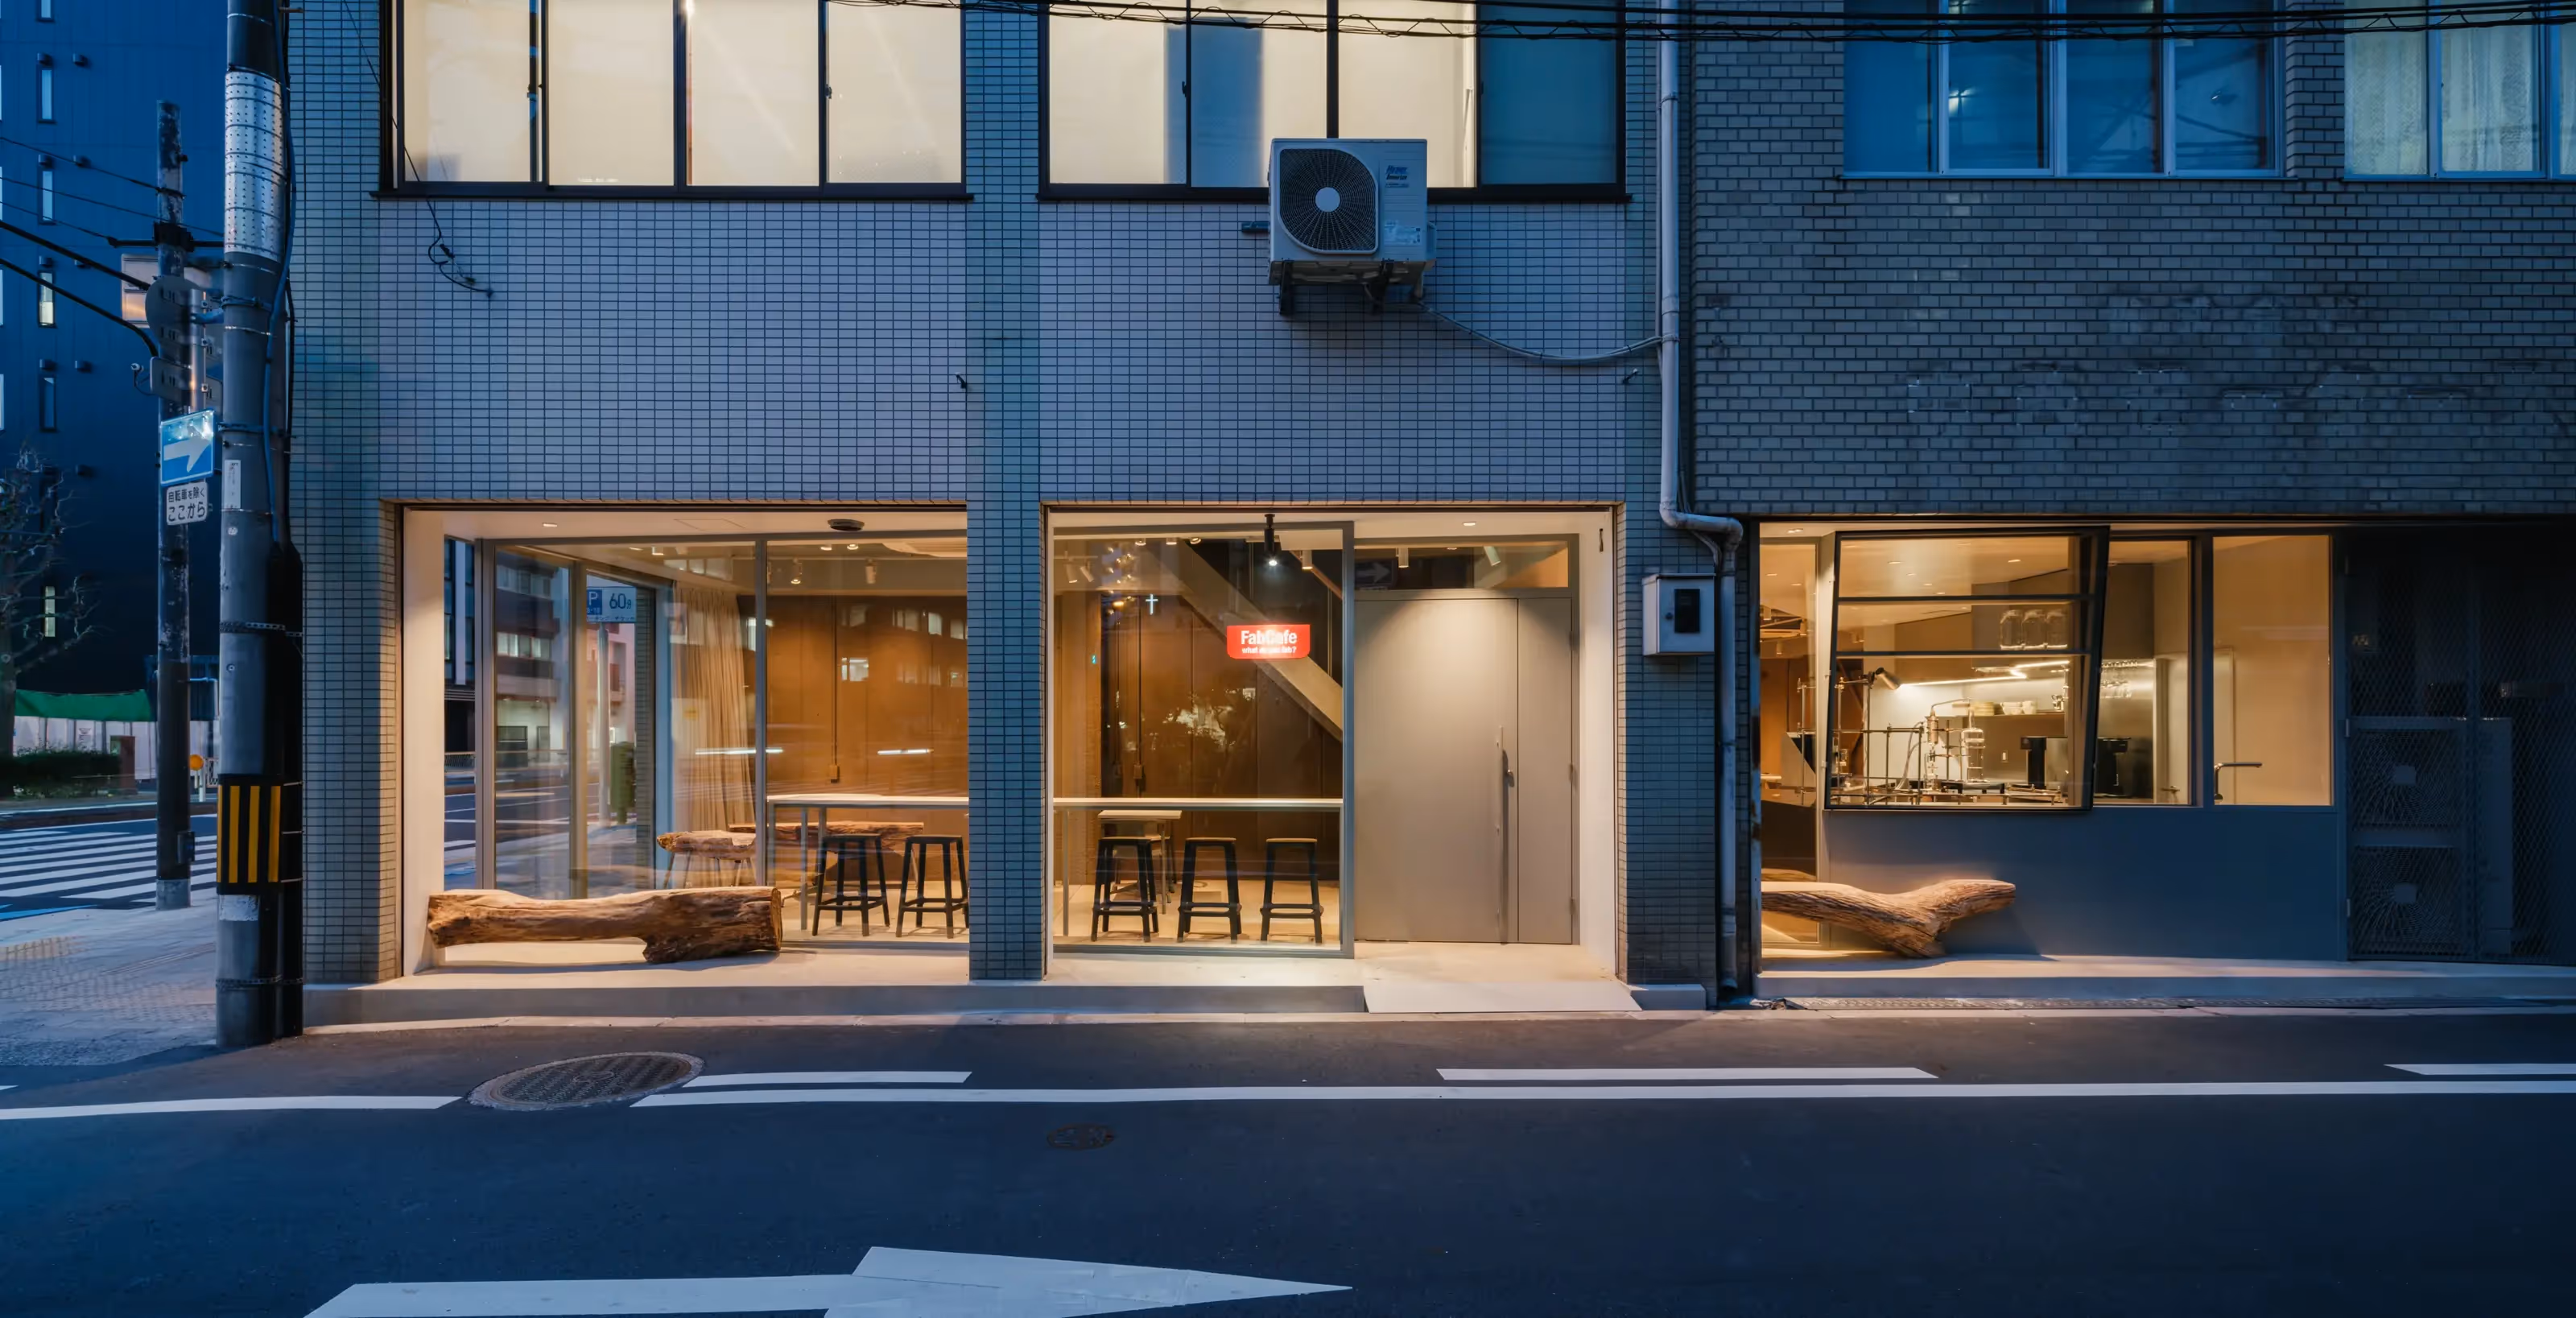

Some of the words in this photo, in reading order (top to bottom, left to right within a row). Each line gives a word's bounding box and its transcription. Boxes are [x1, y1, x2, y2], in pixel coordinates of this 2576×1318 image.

[168, 486, 204, 502] 自転車を除く
[168, 501, 205, 522] ここから
[588, 591, 598, 605] P
[1241, 630, 1297, 645] FabCafe
